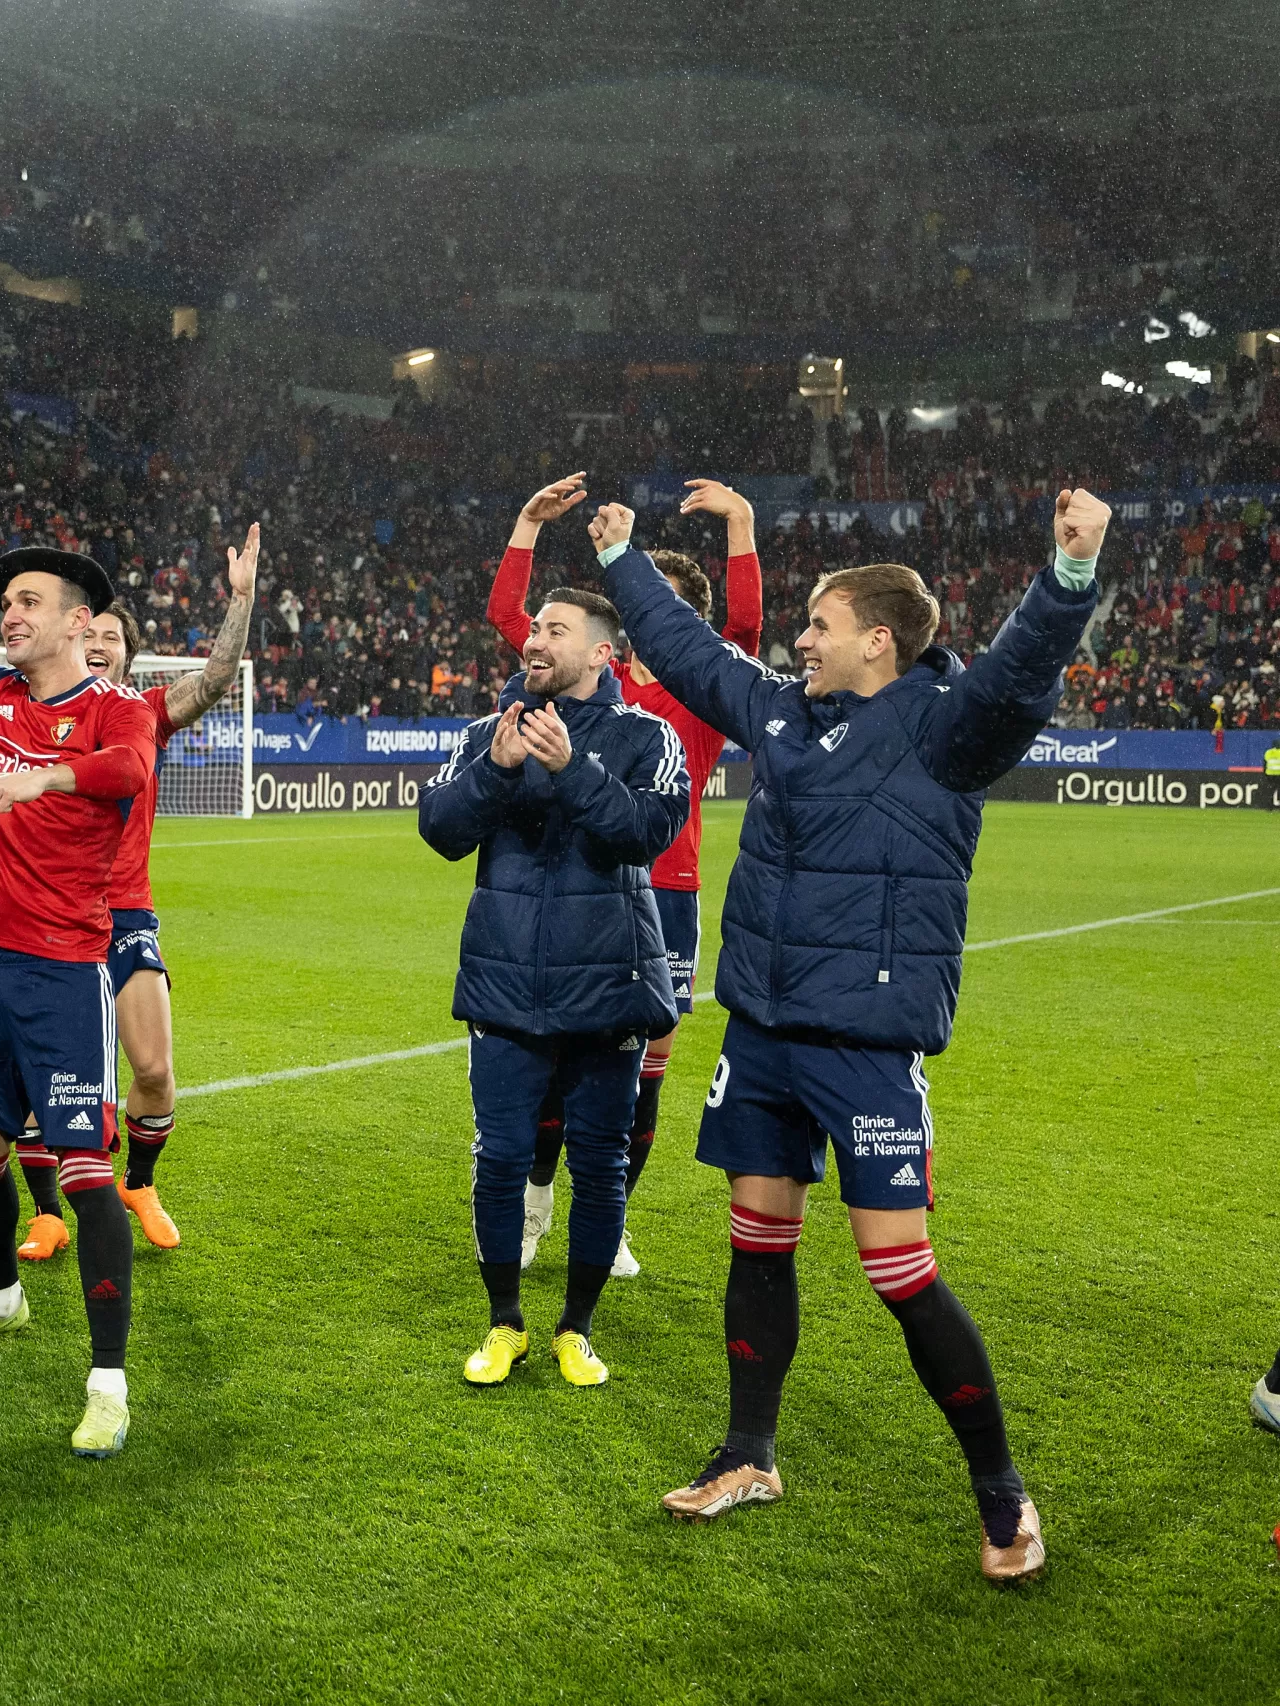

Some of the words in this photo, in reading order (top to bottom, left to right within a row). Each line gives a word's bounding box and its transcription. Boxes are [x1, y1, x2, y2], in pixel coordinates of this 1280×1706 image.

[208, 721, 264, 748] Halcn
[252, 772, 346, 813] Orgullo
[353, 780, 391, 811] por
[1057, 772, 1187, 807] ¡Orgullo
[1200, 782, 1258, 809] por
[706, 1053, 731, 1108] 9
[50, 1082, 102, 1096] Universidad
[59, 1094, 98, 1106] Navarra
[67, 1123, 95, 1131] adidas
[852, 1114, 895, 1129] Clínica
[853, 1127, 923, 1142] Universidad
[854, 1143, 871, 1156] de
[874, 1142, 921, 1156] Navarra
[890, 1177, 921, 1187] adidas
